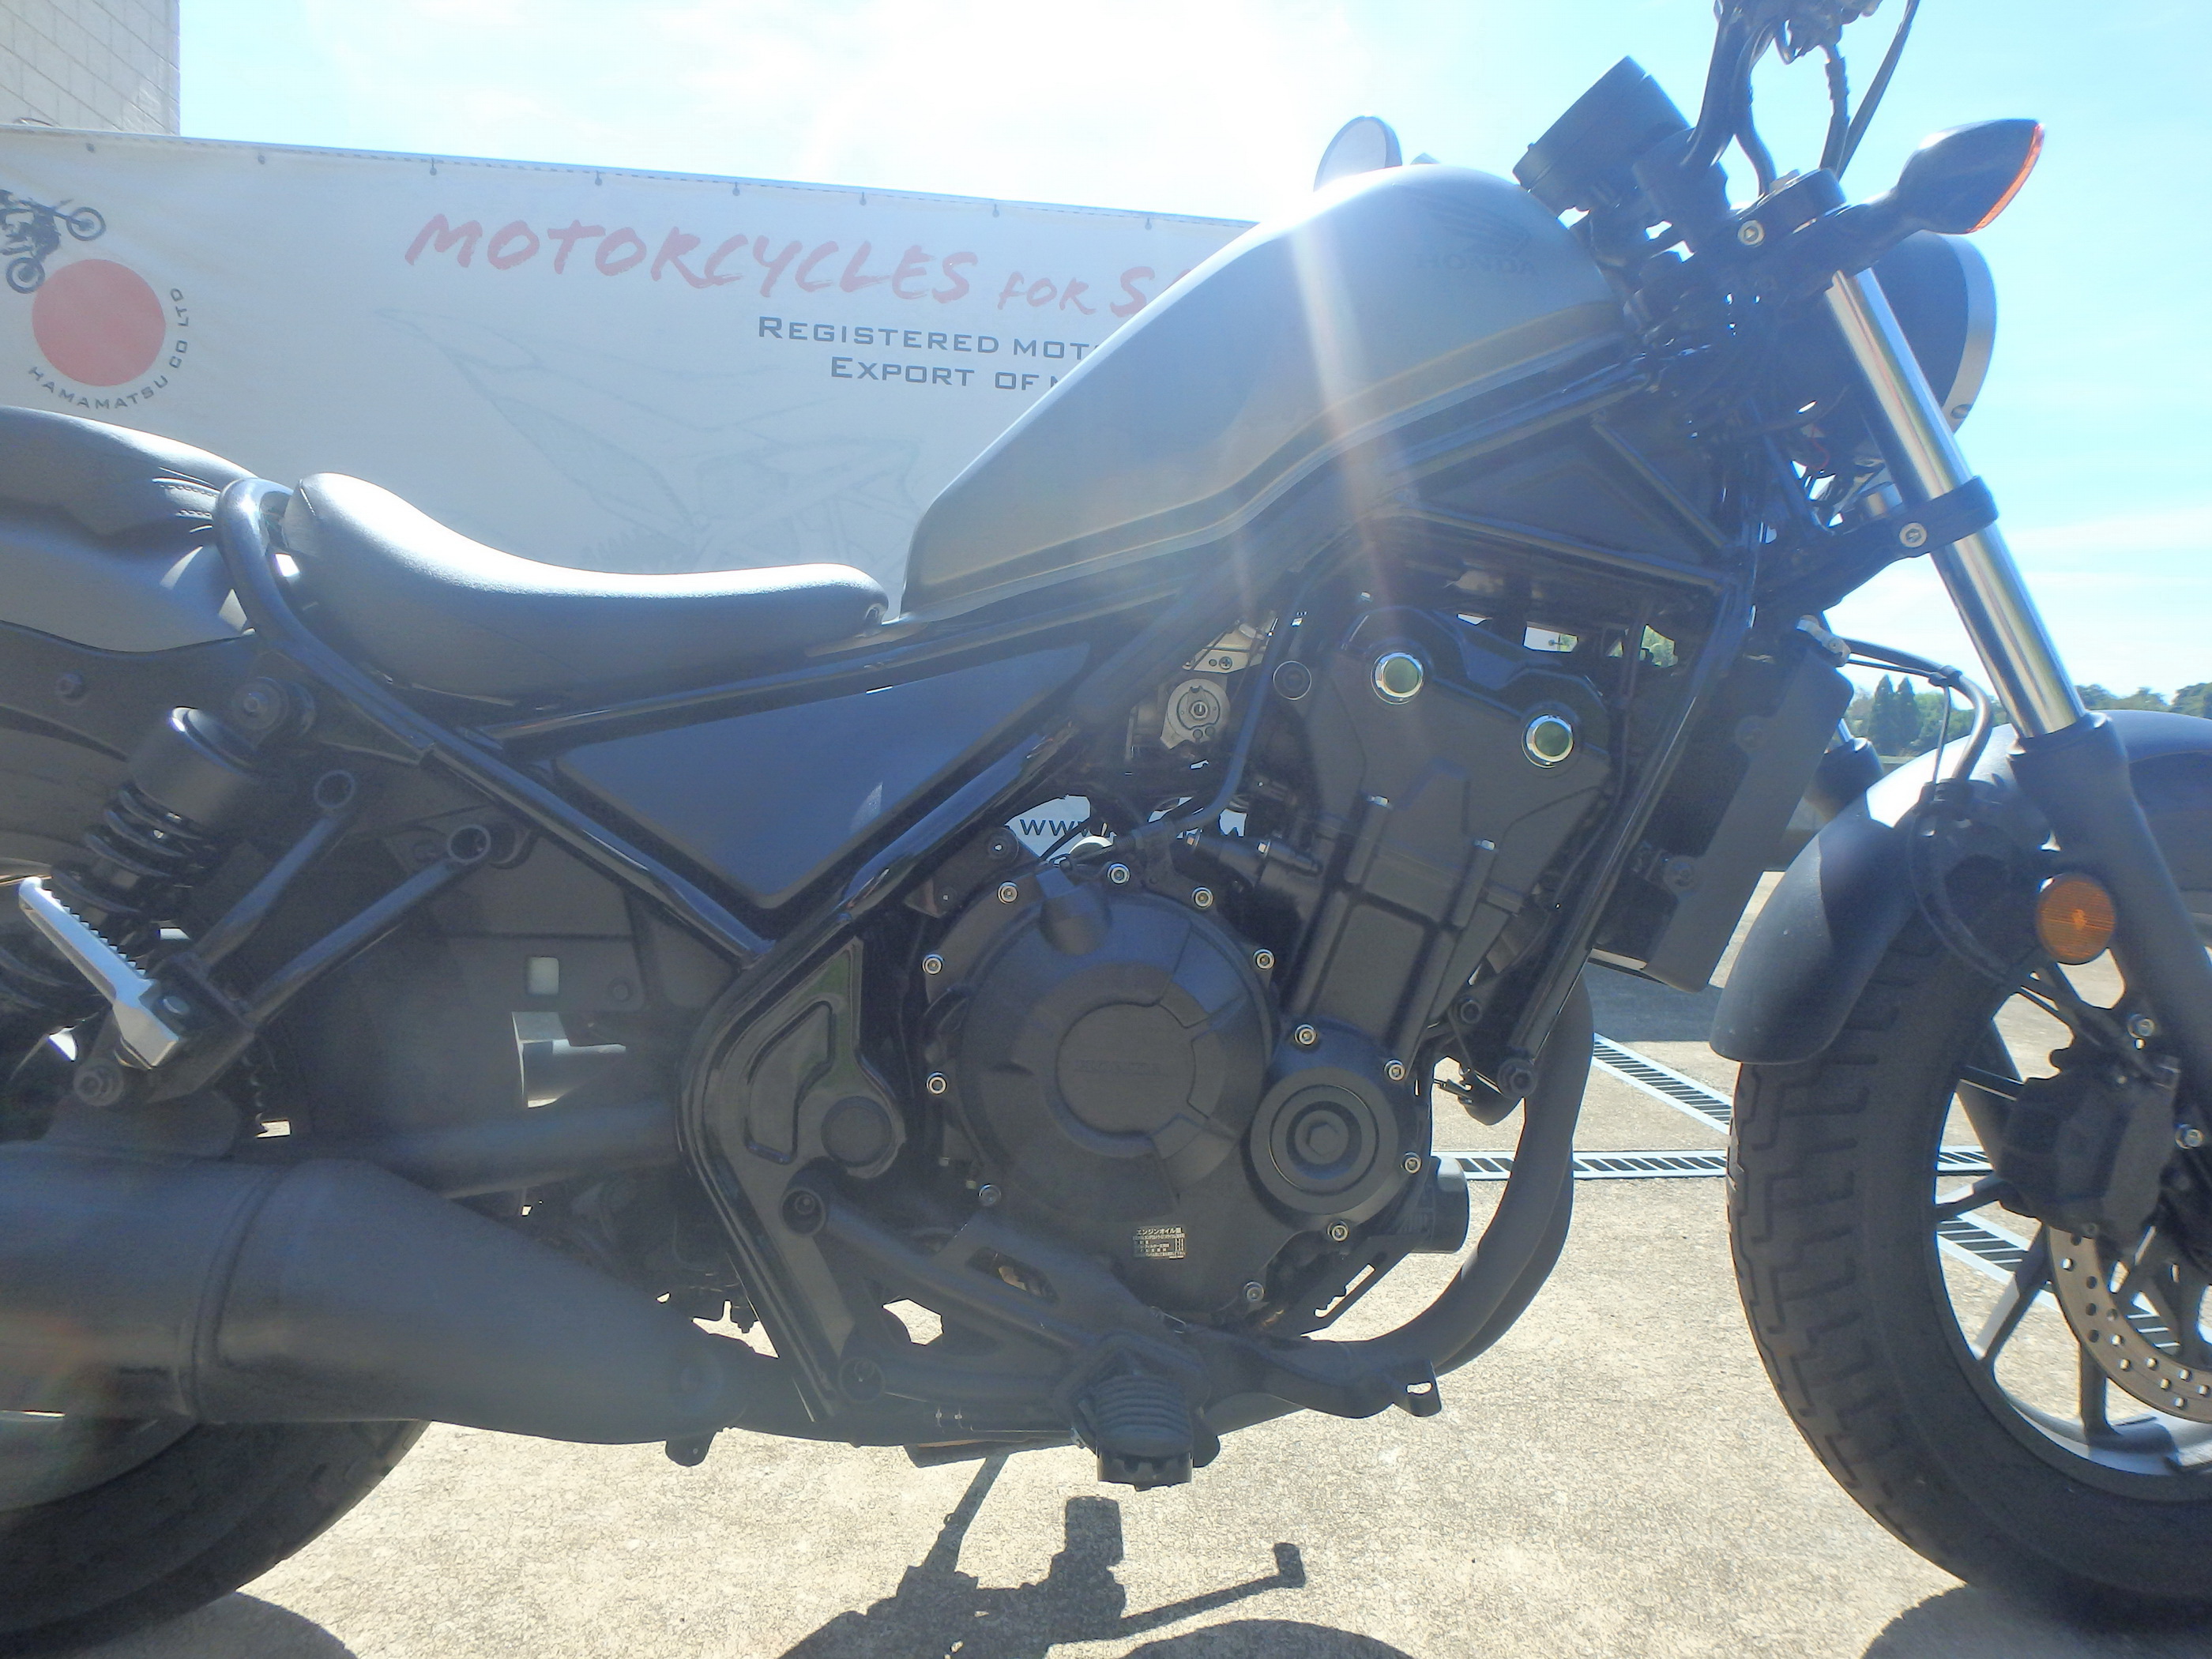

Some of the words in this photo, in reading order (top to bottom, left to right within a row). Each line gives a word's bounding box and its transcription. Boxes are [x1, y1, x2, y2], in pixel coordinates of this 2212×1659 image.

[404, 213, 979, 304] MOTORCYCLES
[1110, 265, 1192, 318] S
[1416, 253, 1540, 275] HONDA
[170, 288, 189, 326] LTD
[169, 340, 188, 368] CO
[1014, 338, 1100, 360] MOT
[28, 366, 168, 409] HAMAMATSU
